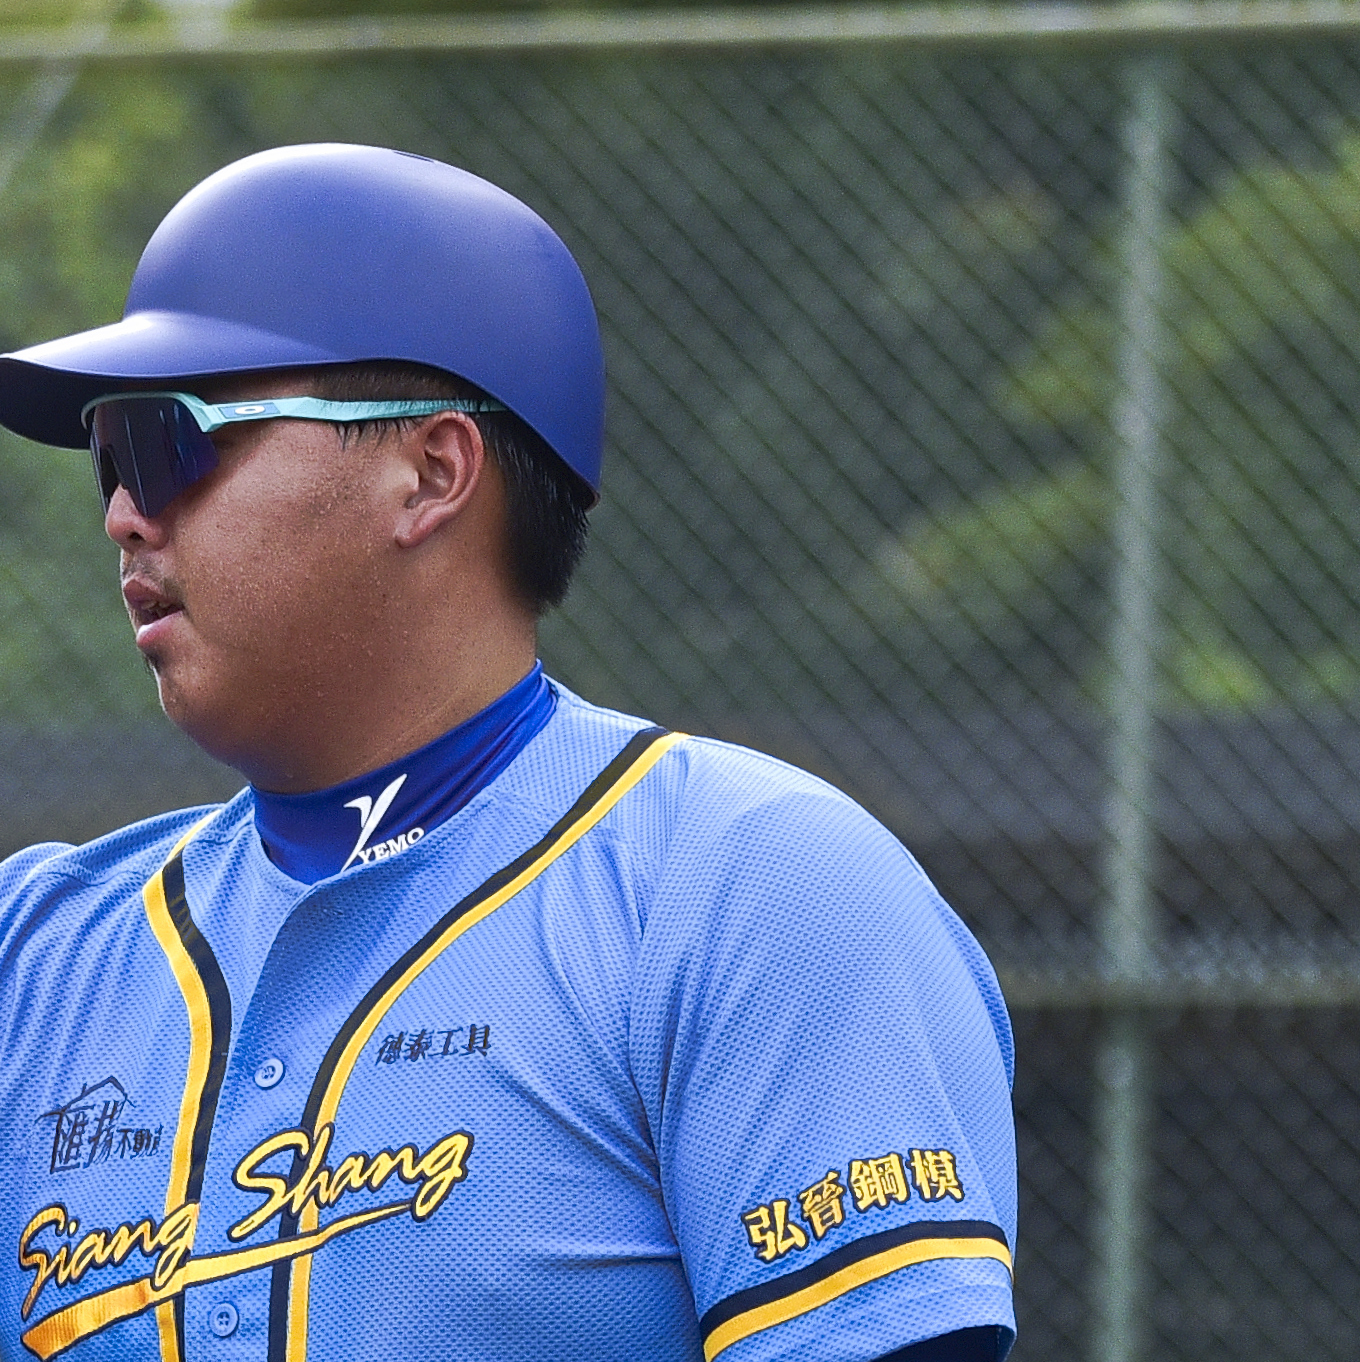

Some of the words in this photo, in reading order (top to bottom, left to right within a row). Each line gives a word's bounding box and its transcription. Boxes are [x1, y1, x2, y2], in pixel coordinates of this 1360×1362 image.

[358, 827, 425, 865] YEMO
[19, 1202, 200, 1319] Siang
[229, 1123, 474, 1243] Shang
[742, 1149, 965, 1262] 弘晉鋼模
